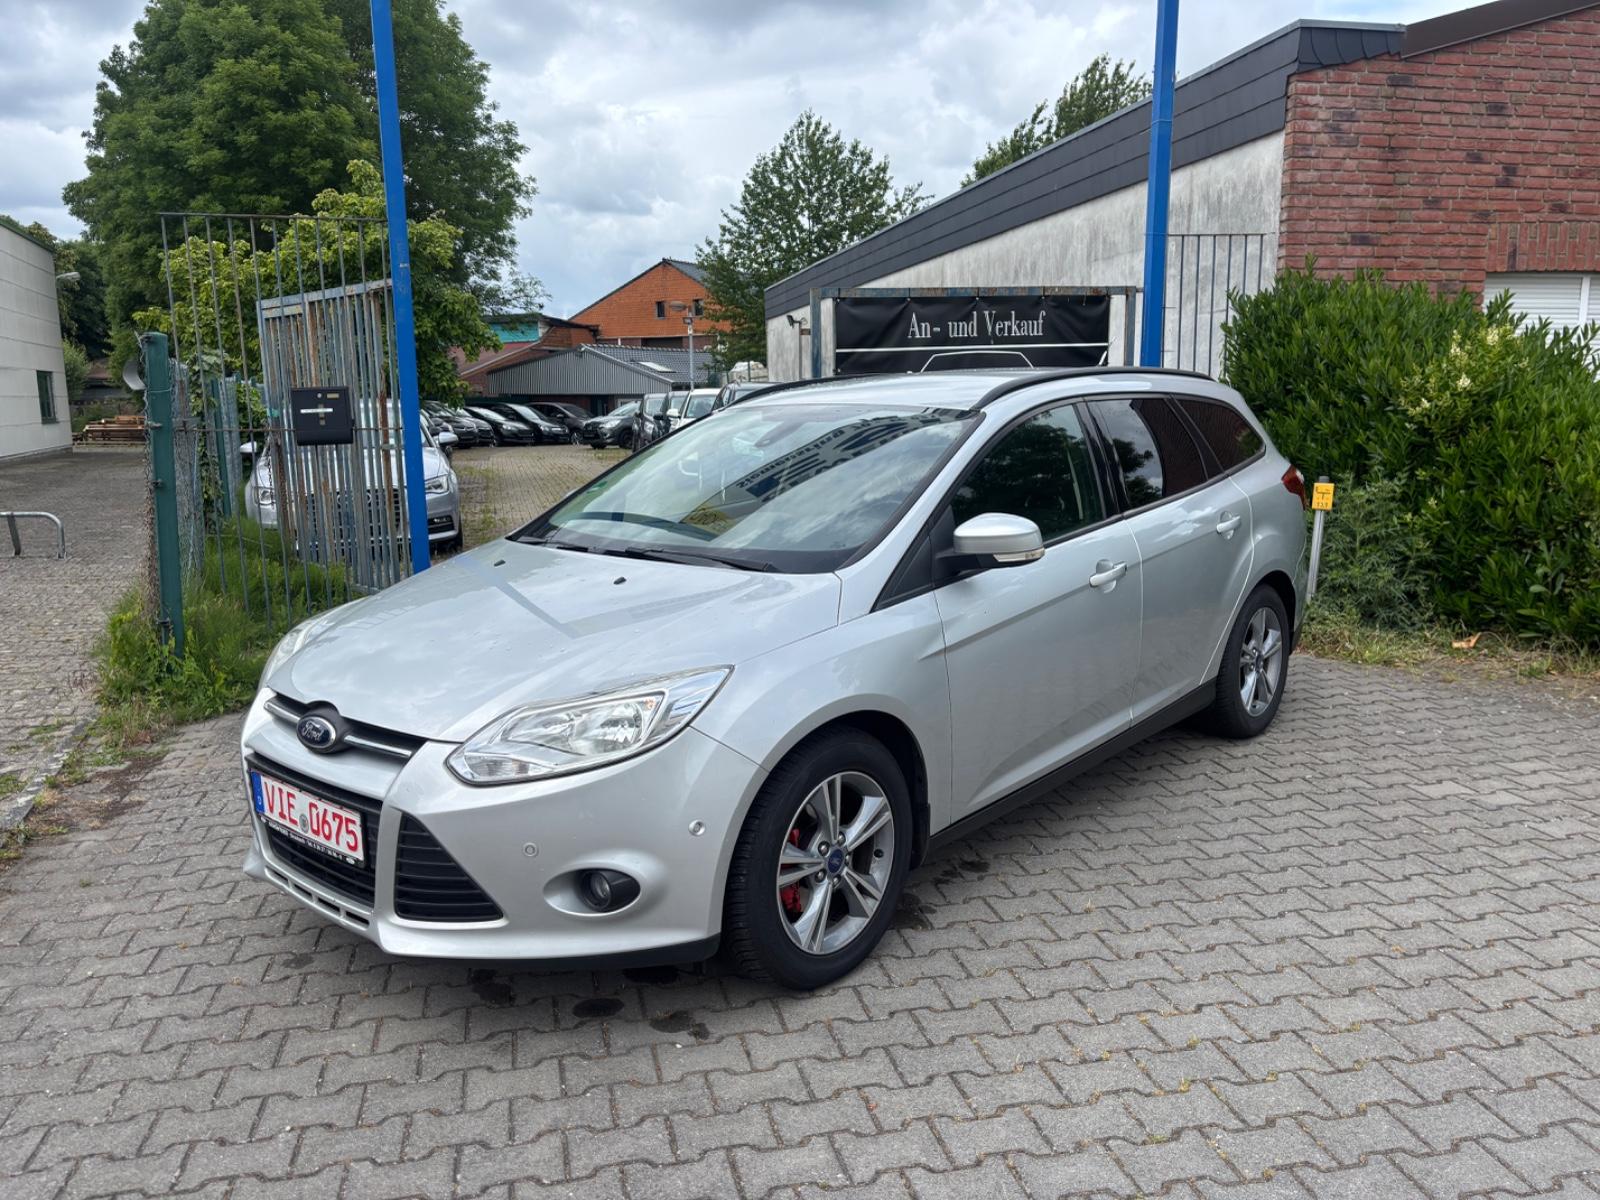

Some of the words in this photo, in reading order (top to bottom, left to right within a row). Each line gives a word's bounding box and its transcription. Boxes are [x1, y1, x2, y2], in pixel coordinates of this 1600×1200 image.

[908, 312, 941, 339] An-
[947, 311, 978, 338] und
[984, 309, 1047, 337] Verkauf
[301, 720, 325, 741] Ford
[264, 781, 298, 826] VIE
[309, 801, 358, 852] 0675
